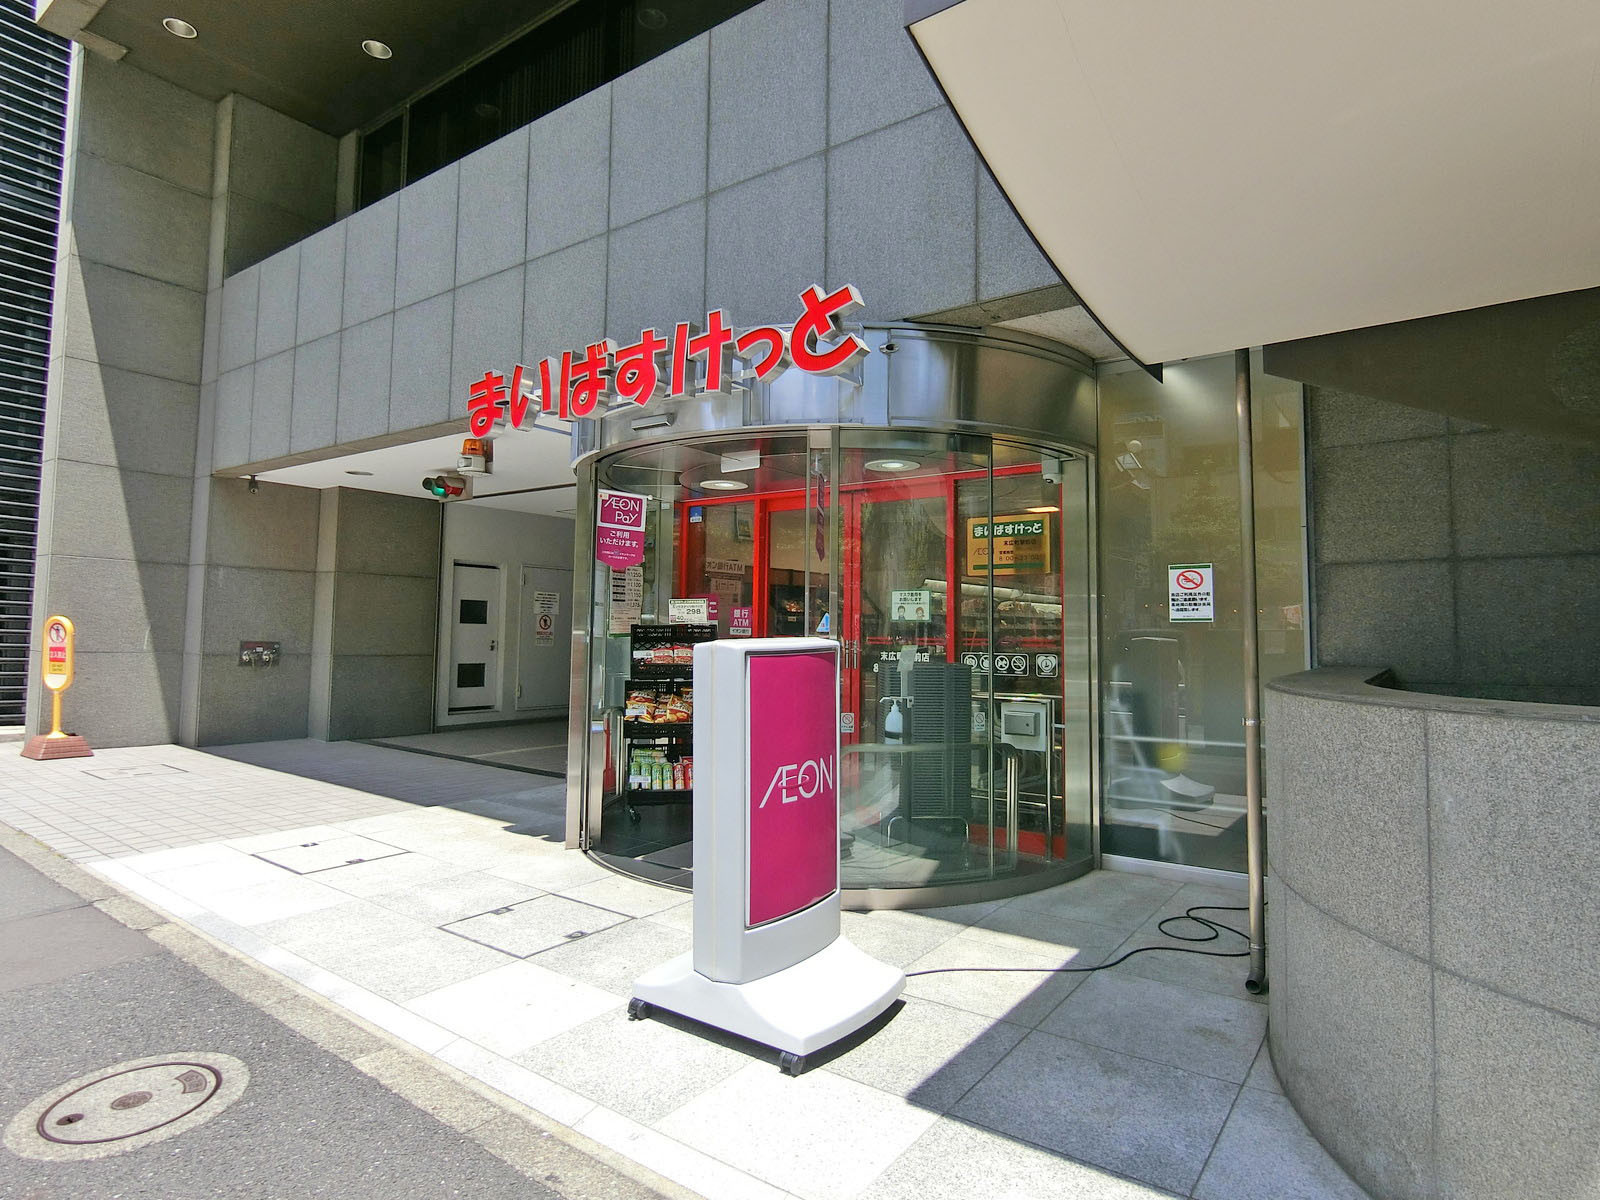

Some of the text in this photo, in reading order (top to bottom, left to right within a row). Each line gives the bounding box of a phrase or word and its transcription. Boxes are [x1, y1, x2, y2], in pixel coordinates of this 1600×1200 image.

[467, 283, 868, 438] まいばすけっと
[609, 530, 630, 540] ご利用
[733, 618, 749, 627] ATM
[880, 651, 930, 663] 末広前店
